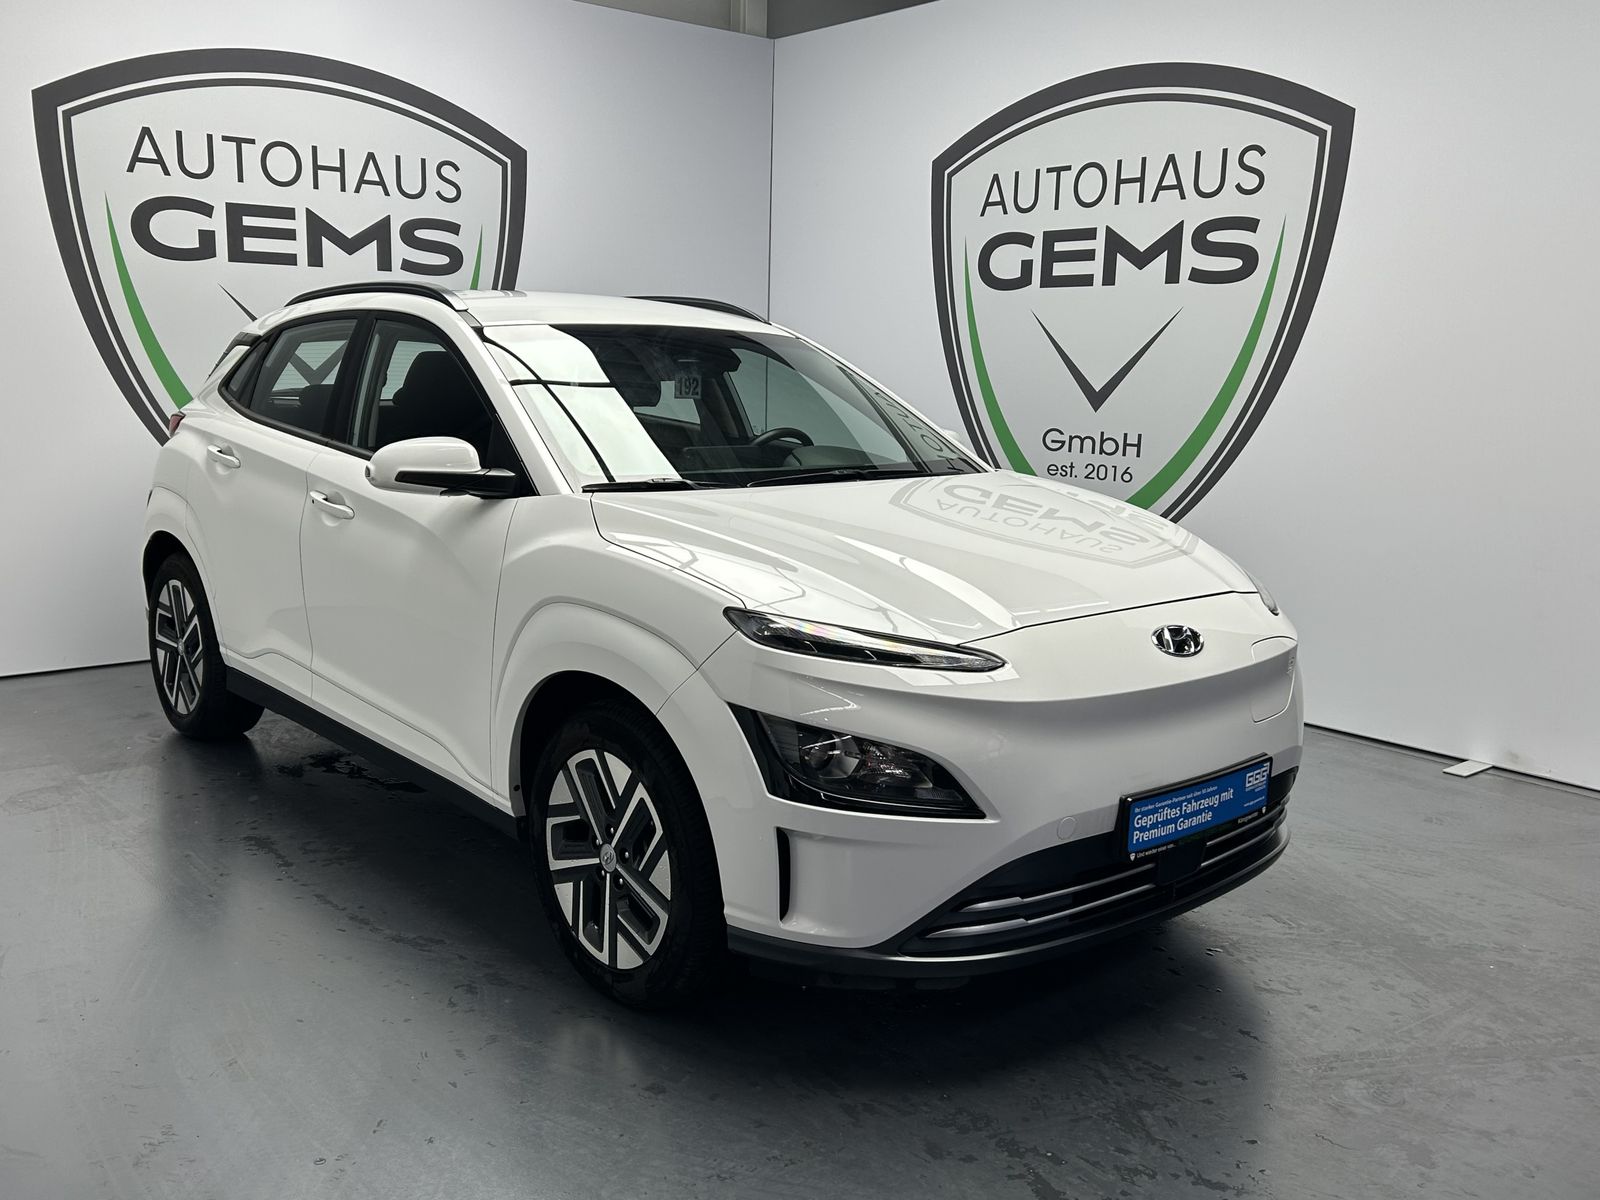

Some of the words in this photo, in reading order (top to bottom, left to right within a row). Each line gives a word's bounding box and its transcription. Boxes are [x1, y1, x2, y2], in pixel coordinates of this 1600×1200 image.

[126, 126, 463, 204] AUTOHAUS
[979, 144, 1266, 217] AUTOHAUS
[130, 195, 464, 276] GEMS
[977, 216, 1260, 291] GEMS
[677, 376, 699, 396] 192
[1041, 427, 1142, 458] GmbH
[1046, 462, 1078, 479] est.
[1084, 463, 1133, 483] 2016
[1132, 824, 1175, 844] Premium
[1176, 810, 1213, 831] Garantie
[1134, 806, 1180, 828] Geprüftes
[1181, 794, 1220, 815] Fahrzeug
[1220, 787, 1234, 802] mit
